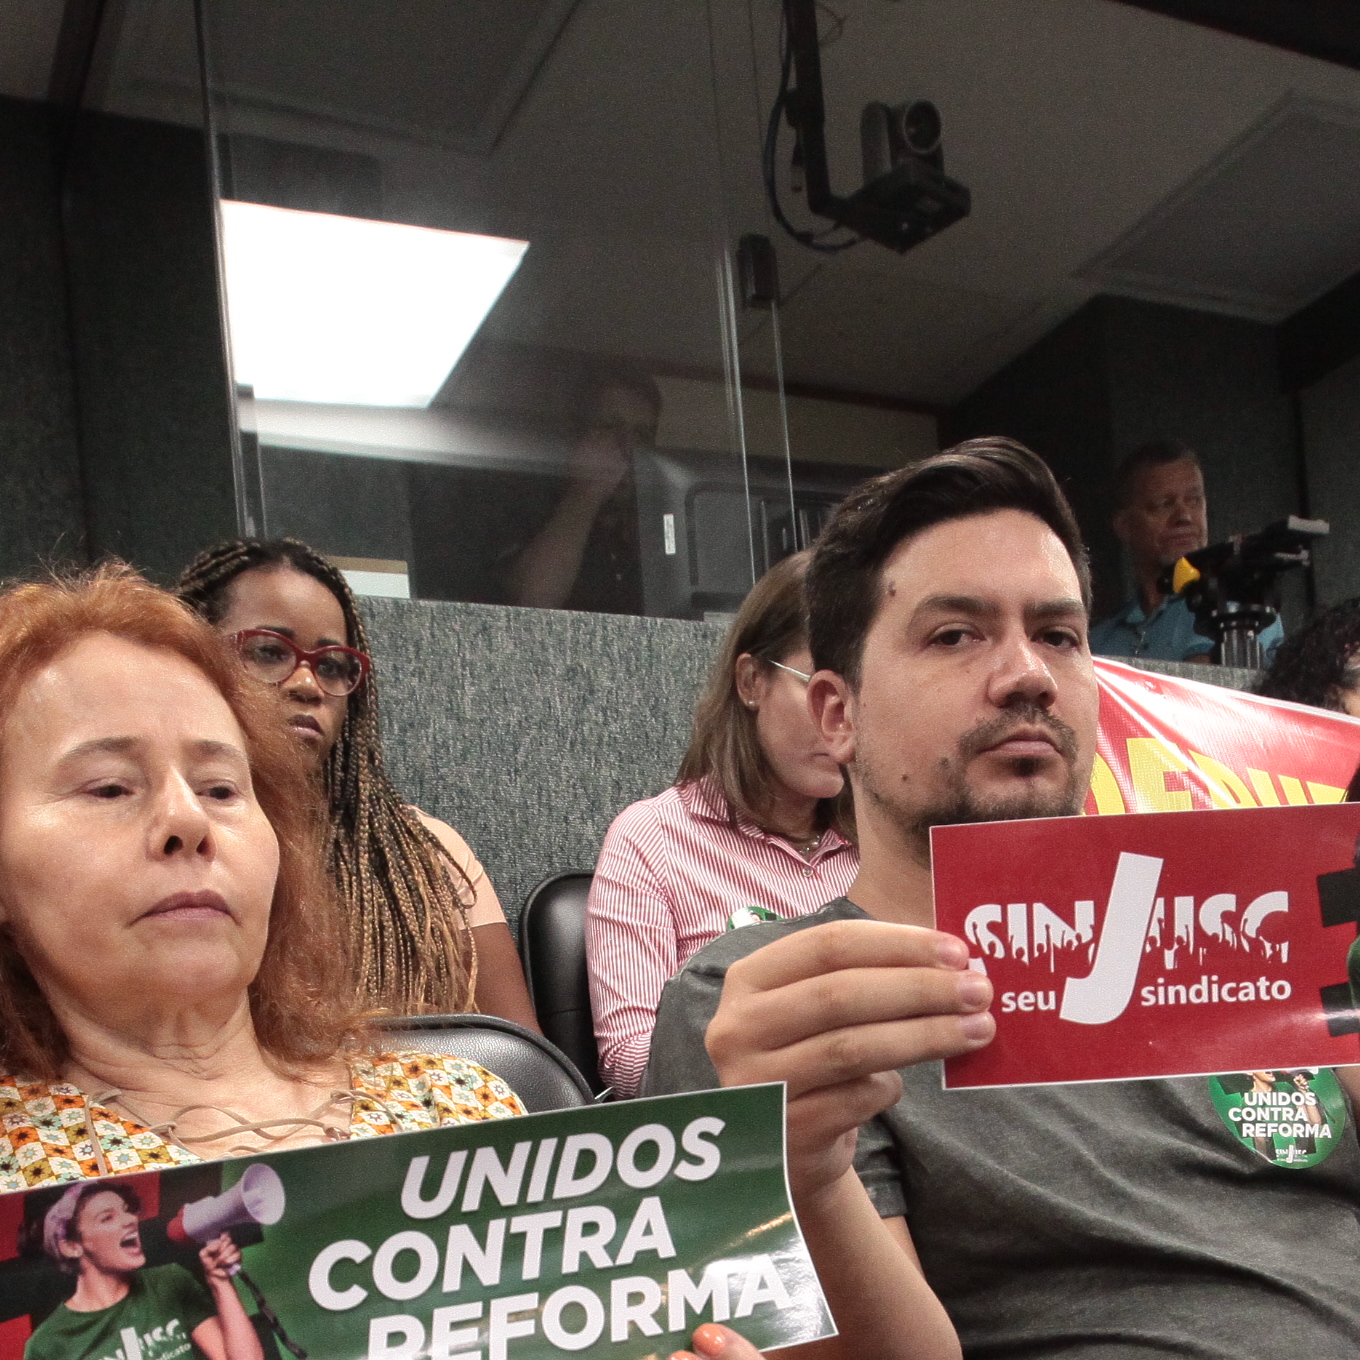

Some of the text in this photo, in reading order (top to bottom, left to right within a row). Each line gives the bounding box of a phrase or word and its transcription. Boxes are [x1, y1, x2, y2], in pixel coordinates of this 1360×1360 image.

[1001, 974, 1292, 1013] seu sindicato
[1244, 1092, 1316, 1106] UNIDOS
[1228, 1107, 1309, 1122] CONTRA
[1242, 1123, 1332, 1138] REFORMA
[400, 1116, 726, 1219] UNIDOS
[307, 1197, 676, 1311] CONTRA
